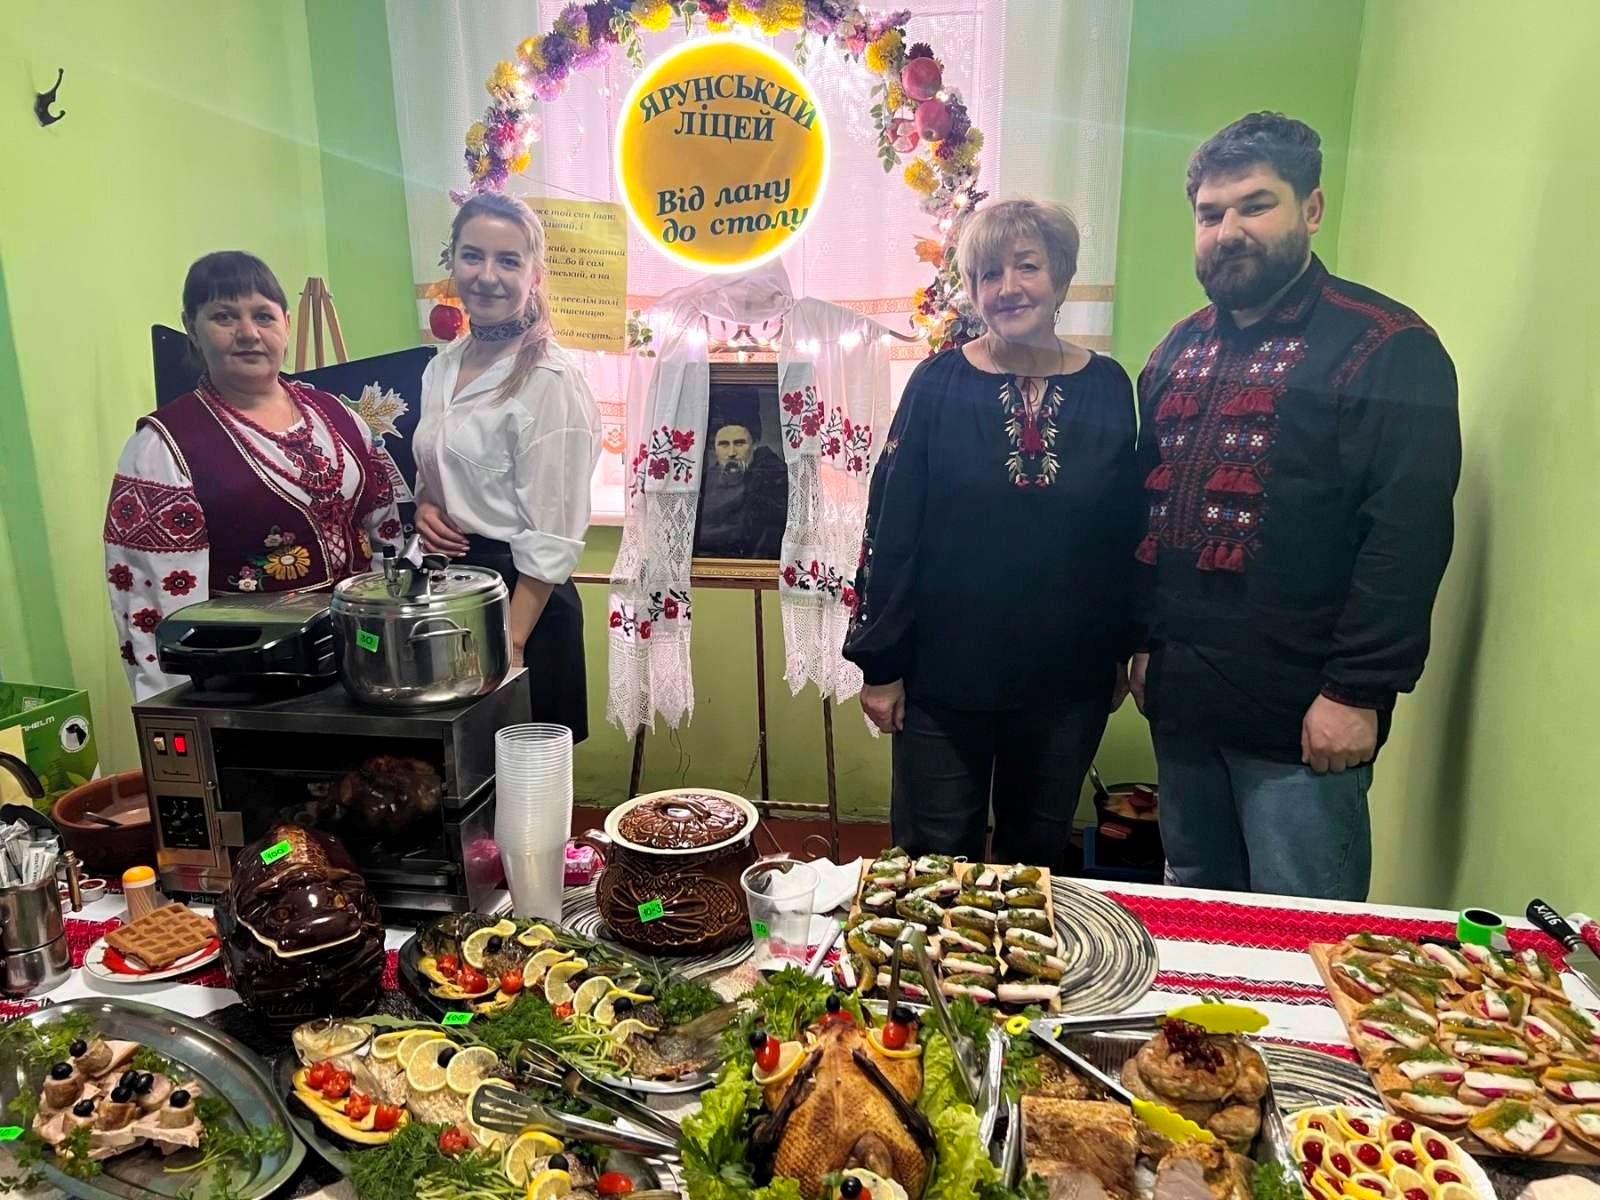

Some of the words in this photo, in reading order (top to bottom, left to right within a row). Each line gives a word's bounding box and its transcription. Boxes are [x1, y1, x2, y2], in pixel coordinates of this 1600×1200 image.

[674, 104, 776, 144] ЛІЦЕЙ
[656, 185, 705, 216] Від
[714, 177, 791, 208] лану
[662, 218, 696, 243] до
[710, 207, 809, 236] столу
